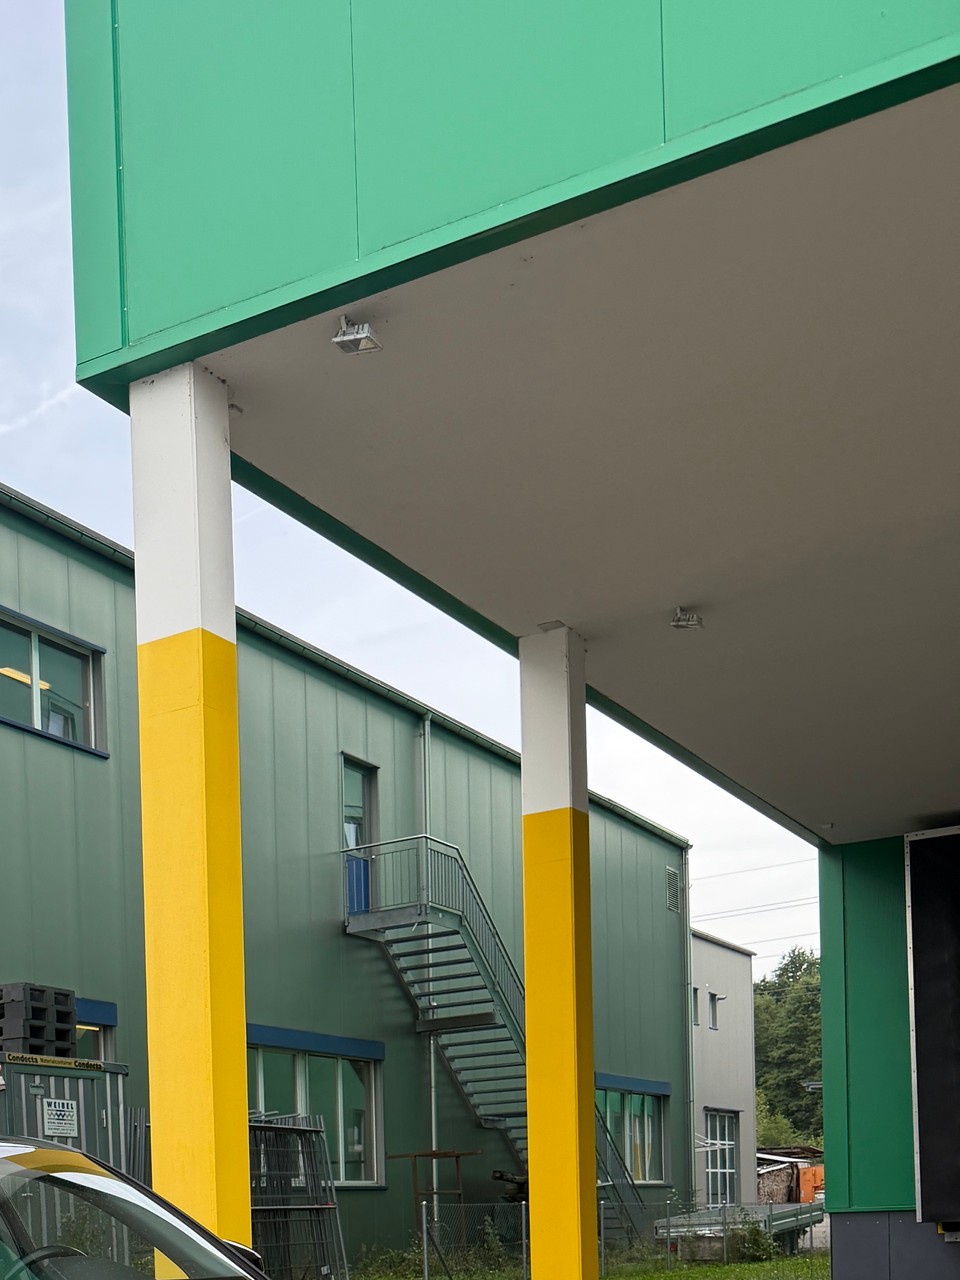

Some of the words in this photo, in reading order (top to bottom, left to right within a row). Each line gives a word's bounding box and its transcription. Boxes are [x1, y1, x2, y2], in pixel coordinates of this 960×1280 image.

[8, 1053, 38, 1064] Condecta
[74, 1060, 102, 1070] Condecta
[46, 1101, 74, 1110] WEIBEL
